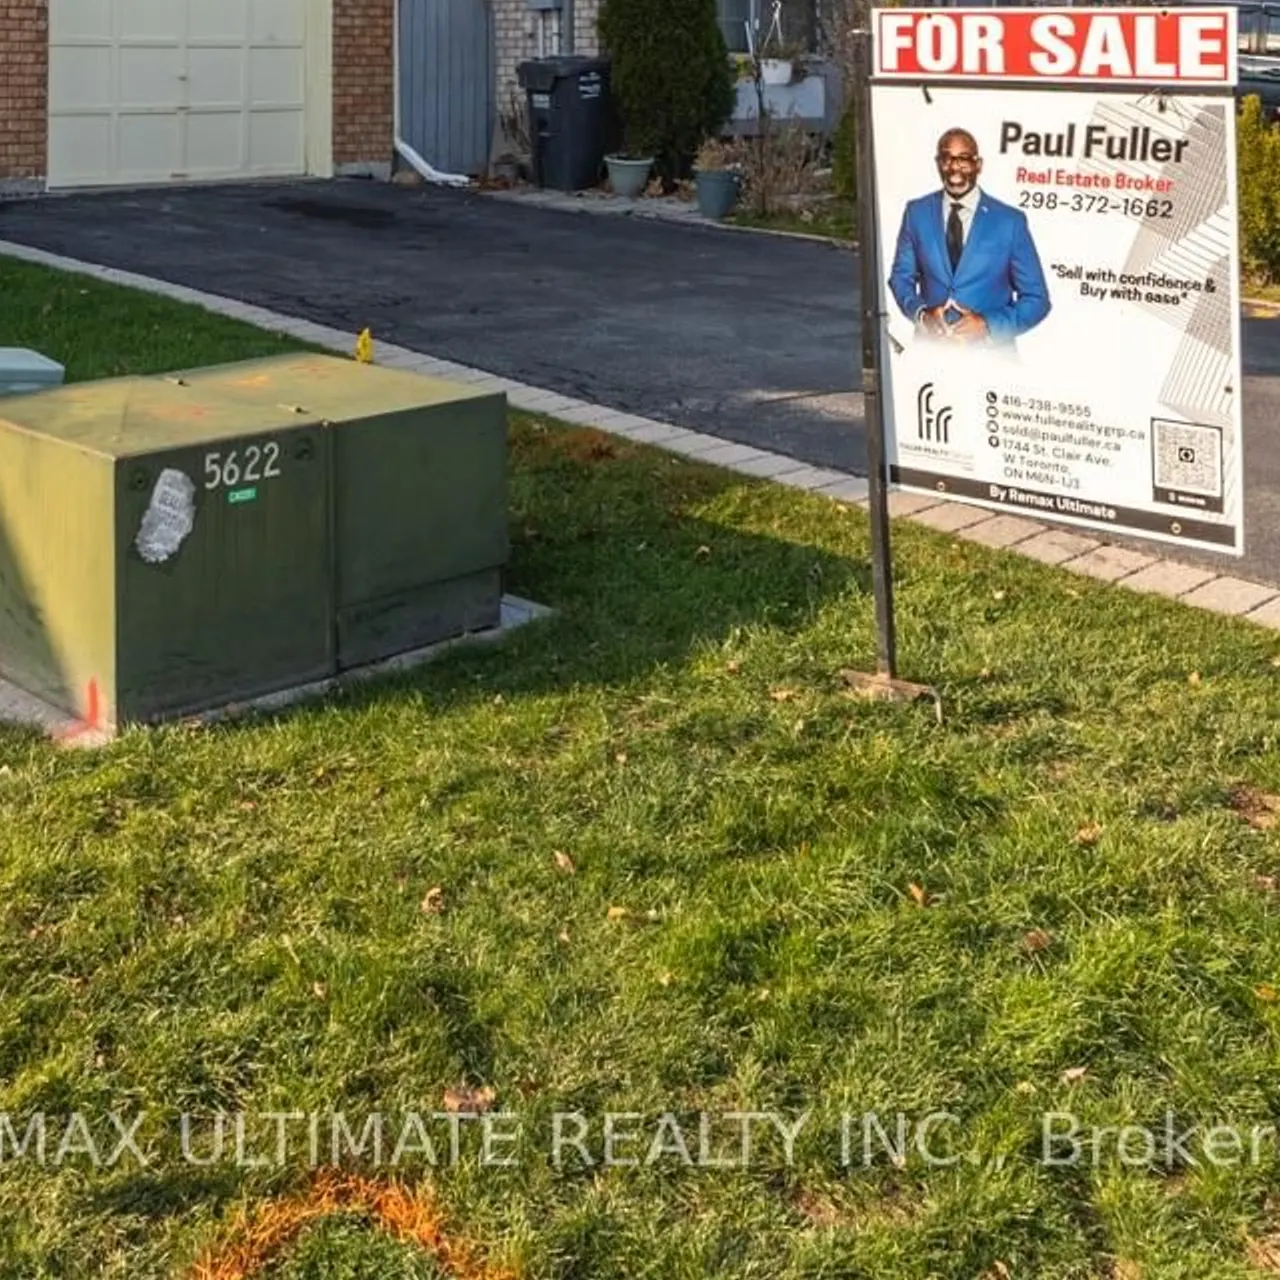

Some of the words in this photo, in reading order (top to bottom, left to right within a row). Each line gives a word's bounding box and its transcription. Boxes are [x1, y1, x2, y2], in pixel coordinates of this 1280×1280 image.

[881, 14, 1005, 73] FOR
[1029, 14, 1226, 77] SALE
[999, 121, 1076, 157] Paul
[1083, 125, 1189, 163] Fuller
[1016, 166, 1052, 184] Real
[1055, 169, 1111, 189] Estate
[1114, 172, 1175, 193] Broker
[1018, 190, 1174, 218] 298-372-1662
[1079, 281, 1107, 300] Buy
[1109, 286, 1143, 302] with
[1085, 268, 1117, 284] with
[1118, 272, 1202, 292] confidence
[1204, 277, 1217, 294] &
[1001, 394, 1092, 418] 416-238-9555
[1003, 437, 1030, 453] 1744
[204, 441, 281, 489] 5622
[988, 483, 1008, 502] By
[1008, 486, 1055, 508] Remax
[1055, 495, 1117, 520] Ultimate
